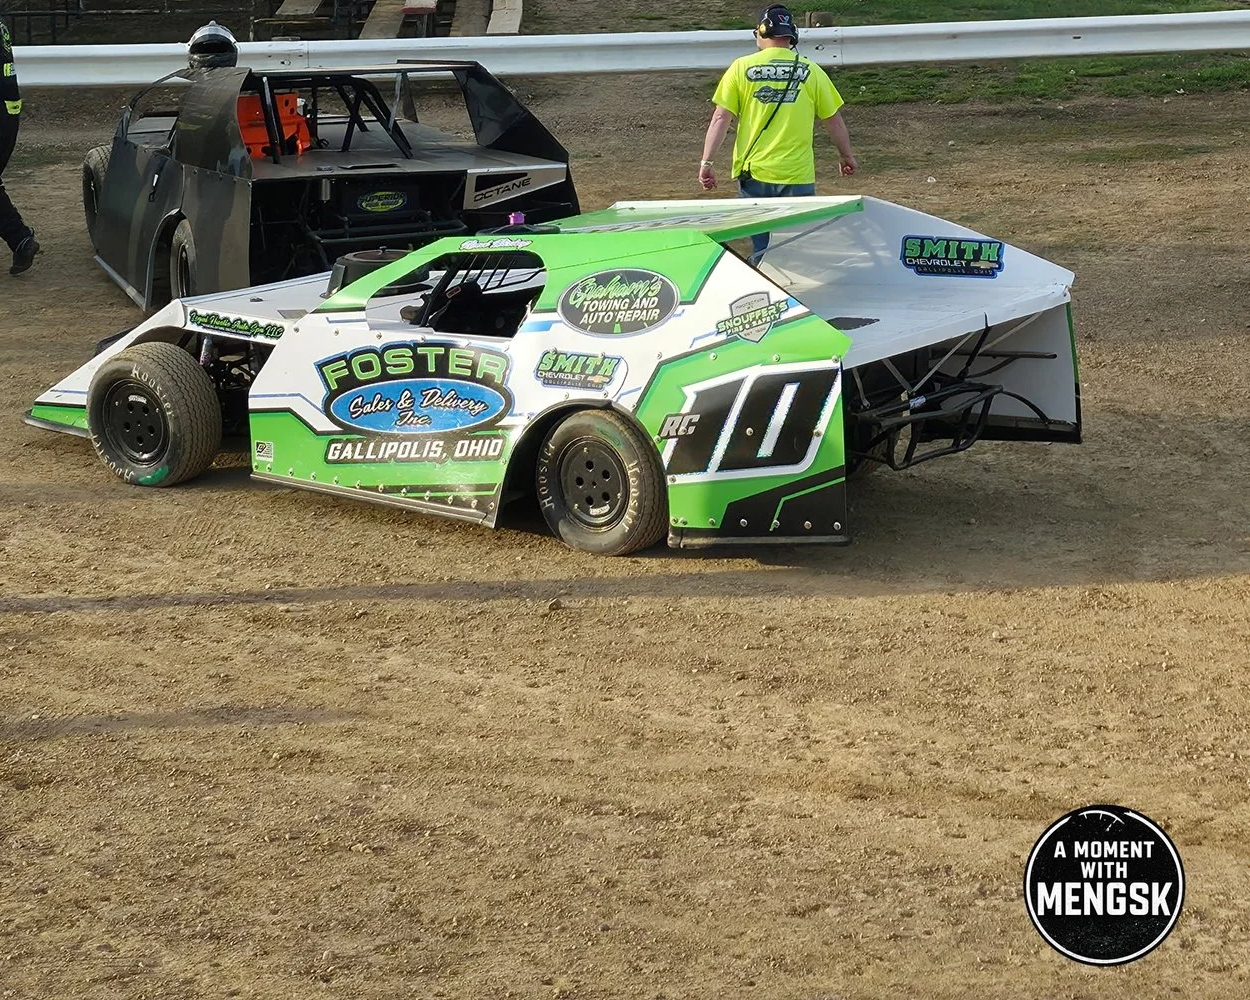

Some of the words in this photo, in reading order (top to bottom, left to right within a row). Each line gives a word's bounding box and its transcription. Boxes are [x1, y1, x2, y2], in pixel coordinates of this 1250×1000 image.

[747, 66, 809, 81] CREW
[473, 178, 532, 202] OCTANE
[905, 238, 1000, 261] SMITH
[906, 258, 966, 267] CHEVROLET
[569, 274, 663, 308] Graham's
[582, 299, 629, 313] TOWING
[631, 297, 659, 310] AND
[717, 300, 788, 332] SNOUFFER'S
[579, 312, 612, 325] AUTO
[615, 309, 660, 323] REPAIR
[265, 325, 285, 338] LLC
[727, 325, 744, 336] FIRE
[322, 347, 508, 390] FOSTER
[539, 352, 622, 376] SMITH
[537, 371, 586, 381] CHEVROLET
[350, 394, 393, 417] Sales
[398, 390, 415, 408] &
[421, 389, 488, 416] Delivery
[395, 411, 431, 426] Inc.
[660, 414, 700, 437] RC
[666, 368, 841, 476] 10
[327, 440, 447, 460] GALLIPOLIS,
[454, 439, 502, 458] OHIO
